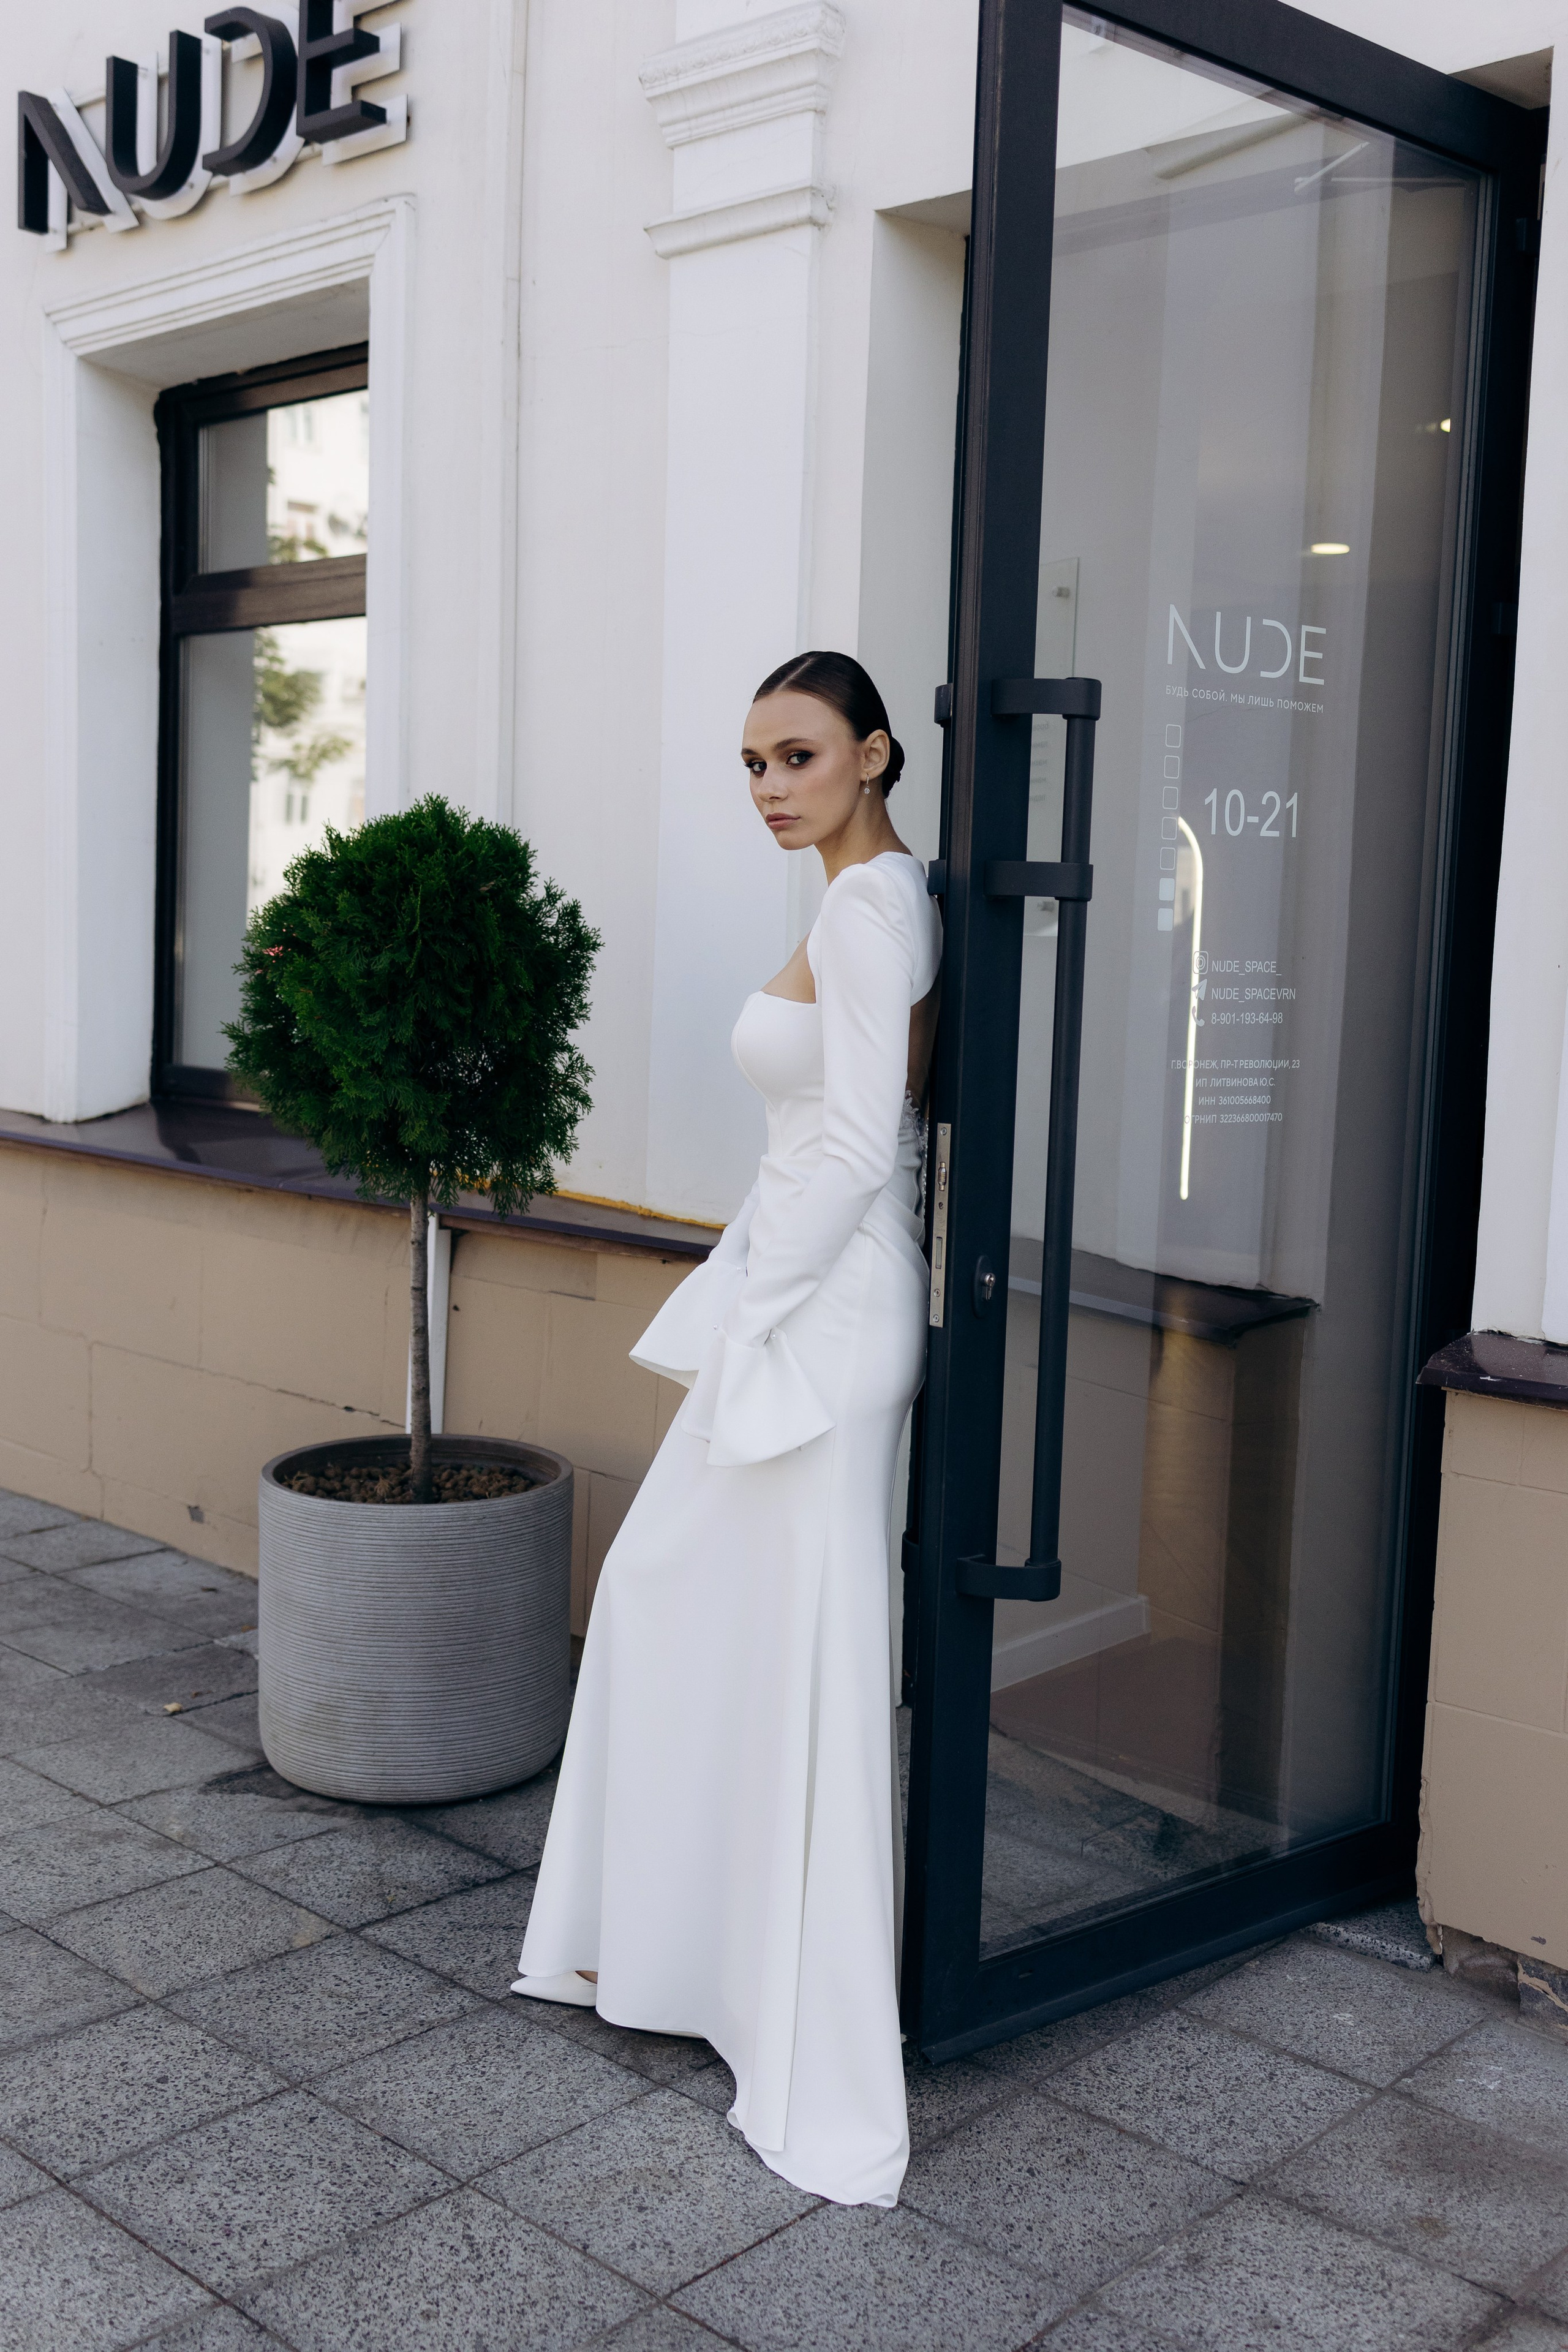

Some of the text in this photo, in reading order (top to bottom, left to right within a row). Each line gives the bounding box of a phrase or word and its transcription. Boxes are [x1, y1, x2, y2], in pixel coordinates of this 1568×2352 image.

[18, 0, 387, 235] NUDE
[1167, 604, 1327, 685] NUDE
[1166, 685, 1324, 713] БУДЬ СОБОЙ. МЫ ЛИШЬ ПОМОЖЕМ
[1204, 788, 1298, 838] 10-21
[1212, 988, 1296, 1003] NUDE_SPACEVRN
[1211, 1012, 1283, 1024] 8-901-193-64-98
[1221, 1060, 1238, 1069] ПР-Т
[1240, 1060, 1291, 1071] РЕВОЛЮЦИИ,
[1292, 1060, 1300, 1068] 23
[1196, 1079, 1207, 1087] ИП
[1210, 1078, 1258, 1087] ЛИТВИНОВА
[1198, 1095, 1272, 1106] ИНН 361005668400
[1219, 1113, 1283, 1123] 322366800017470
